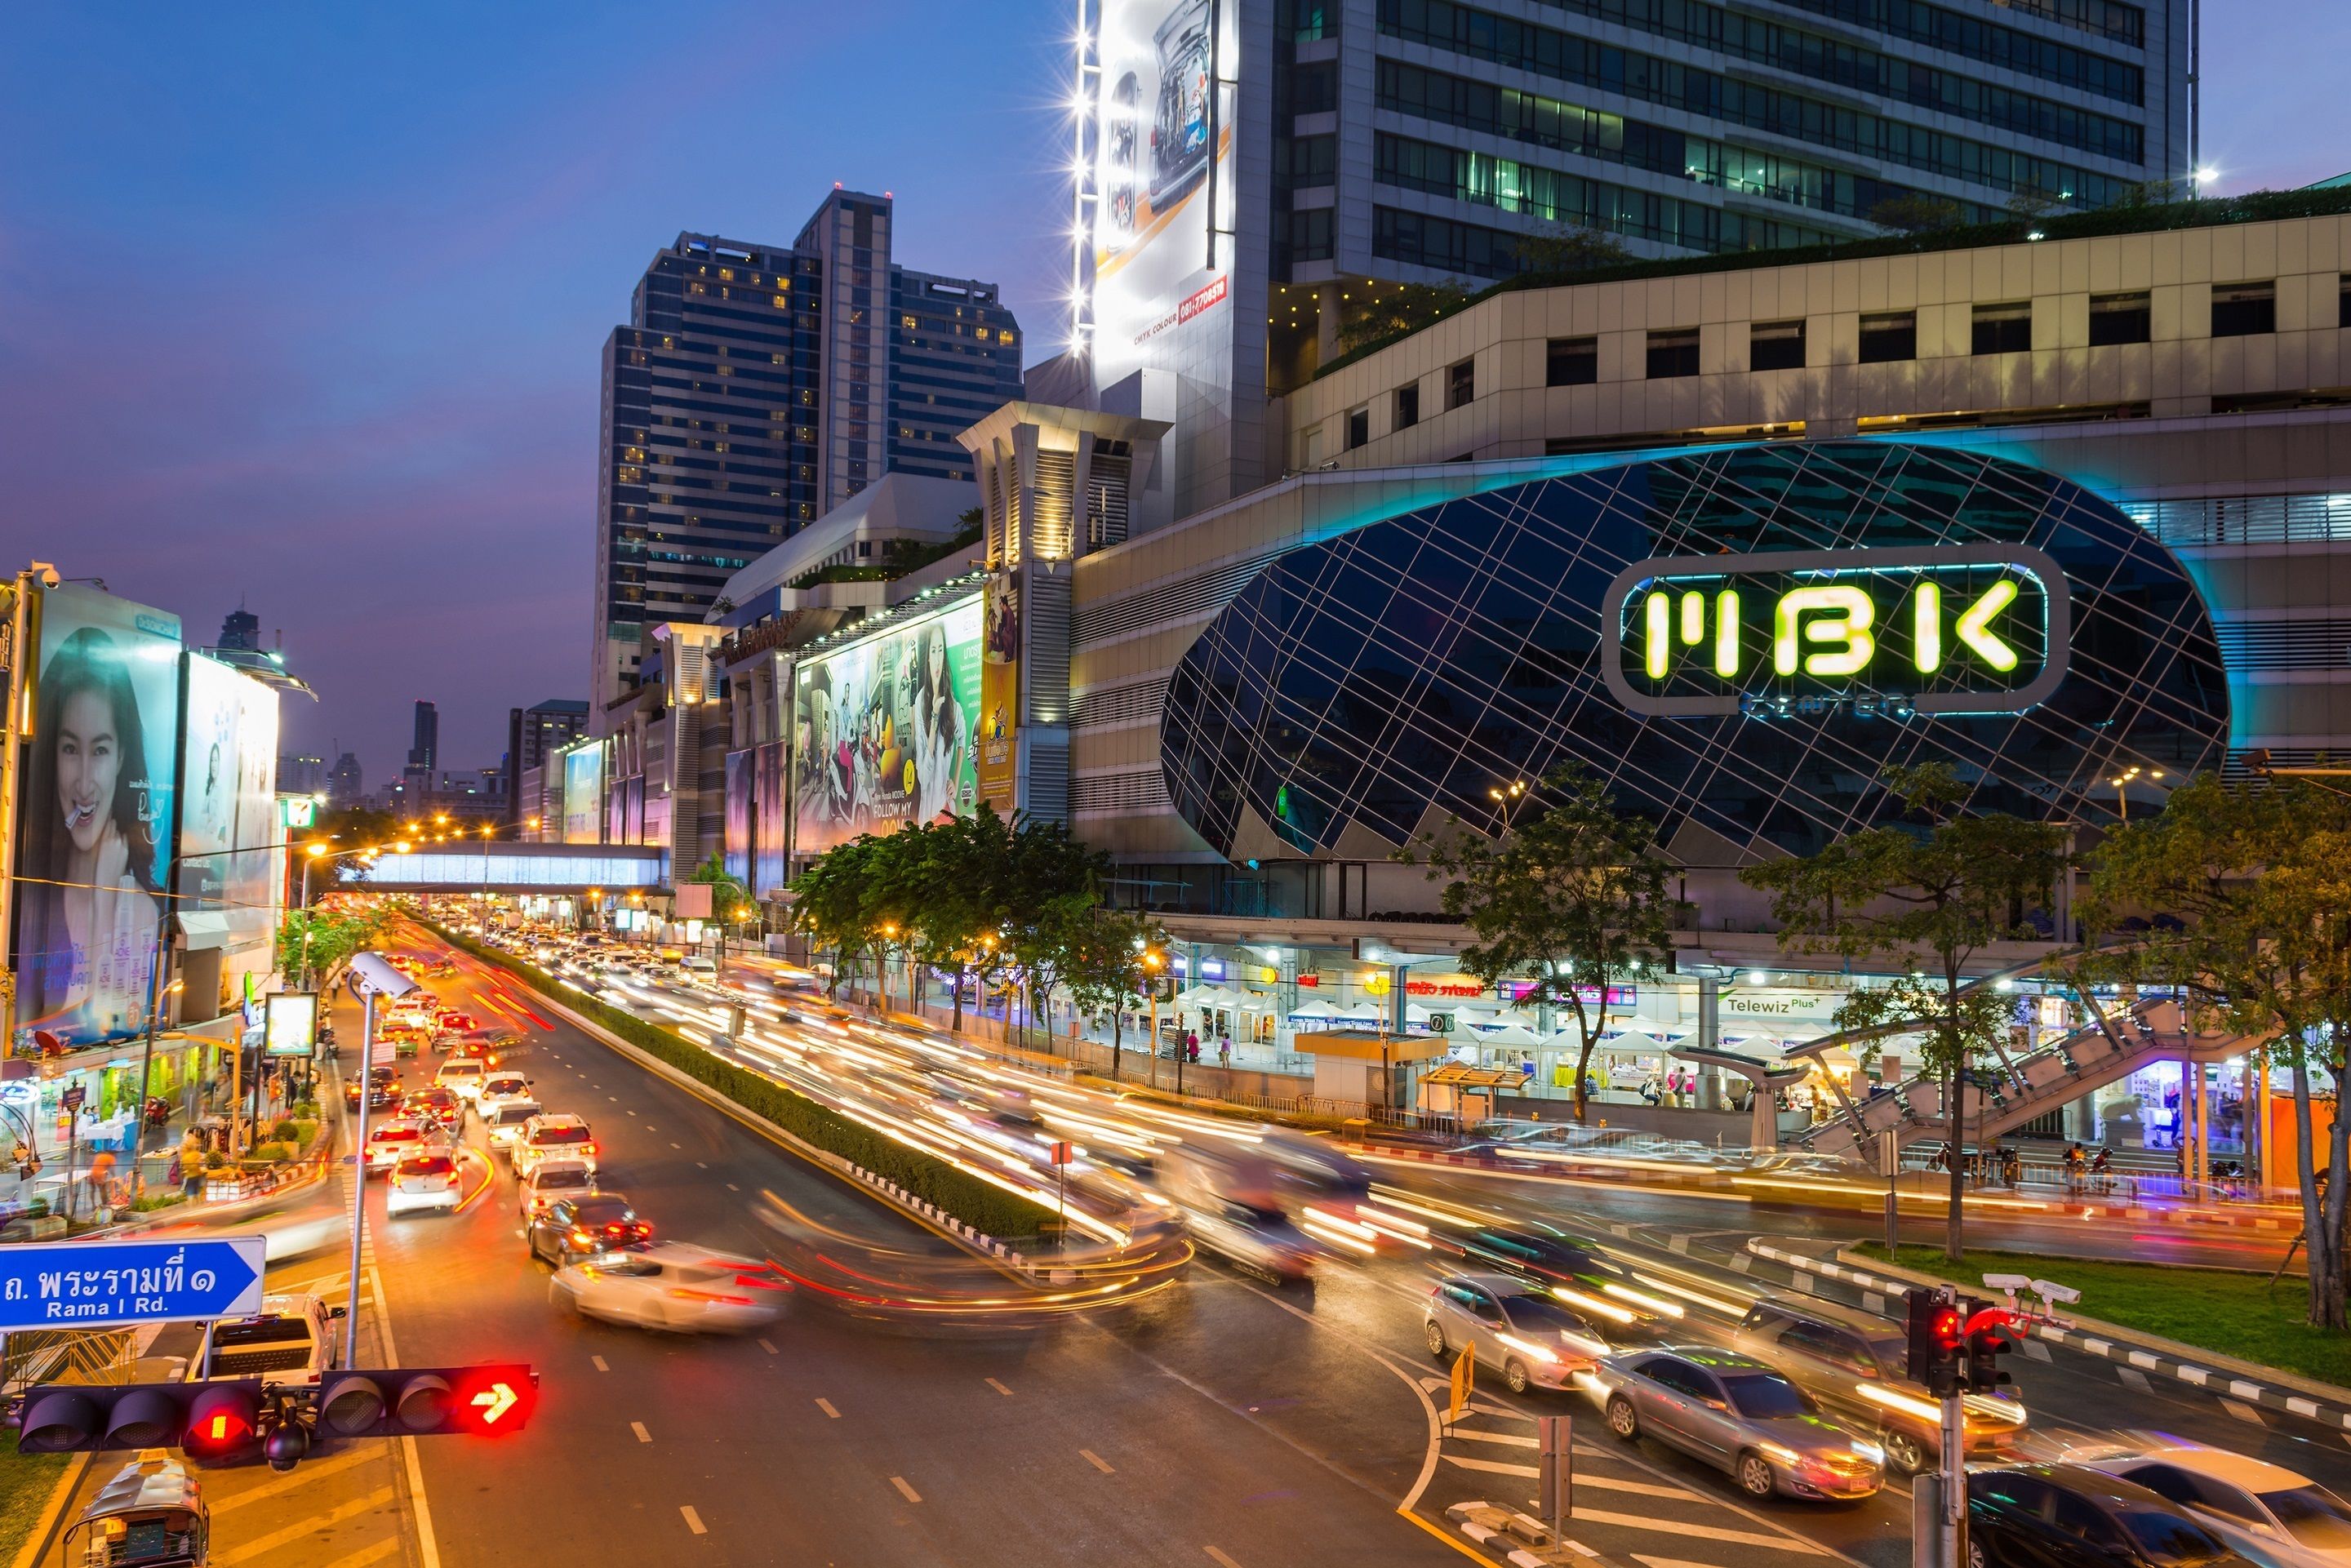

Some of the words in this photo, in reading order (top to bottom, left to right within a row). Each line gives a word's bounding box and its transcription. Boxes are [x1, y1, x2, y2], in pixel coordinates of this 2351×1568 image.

[1134, 329, 1150, 345] CMYK
[1153, 313, 1176, 334] COLOUR
[1647, 580, 2018, 679] MBK
[1749, 695, 1909, 715] CENTER
[874, 802, 900, 819] FOLLOW
[901, 801, 912, 816] MY
[1728, 999, 1789, 1013] Telewiz
[5, 1277, 29, 1300] ถ.
[38, 1246, 185, 1299] พระรามที่
[47, 1300, 109, 1317] Rama
[118, 1299, 124, 1314] I
[135, 1296, 168, 1313] Rd.
